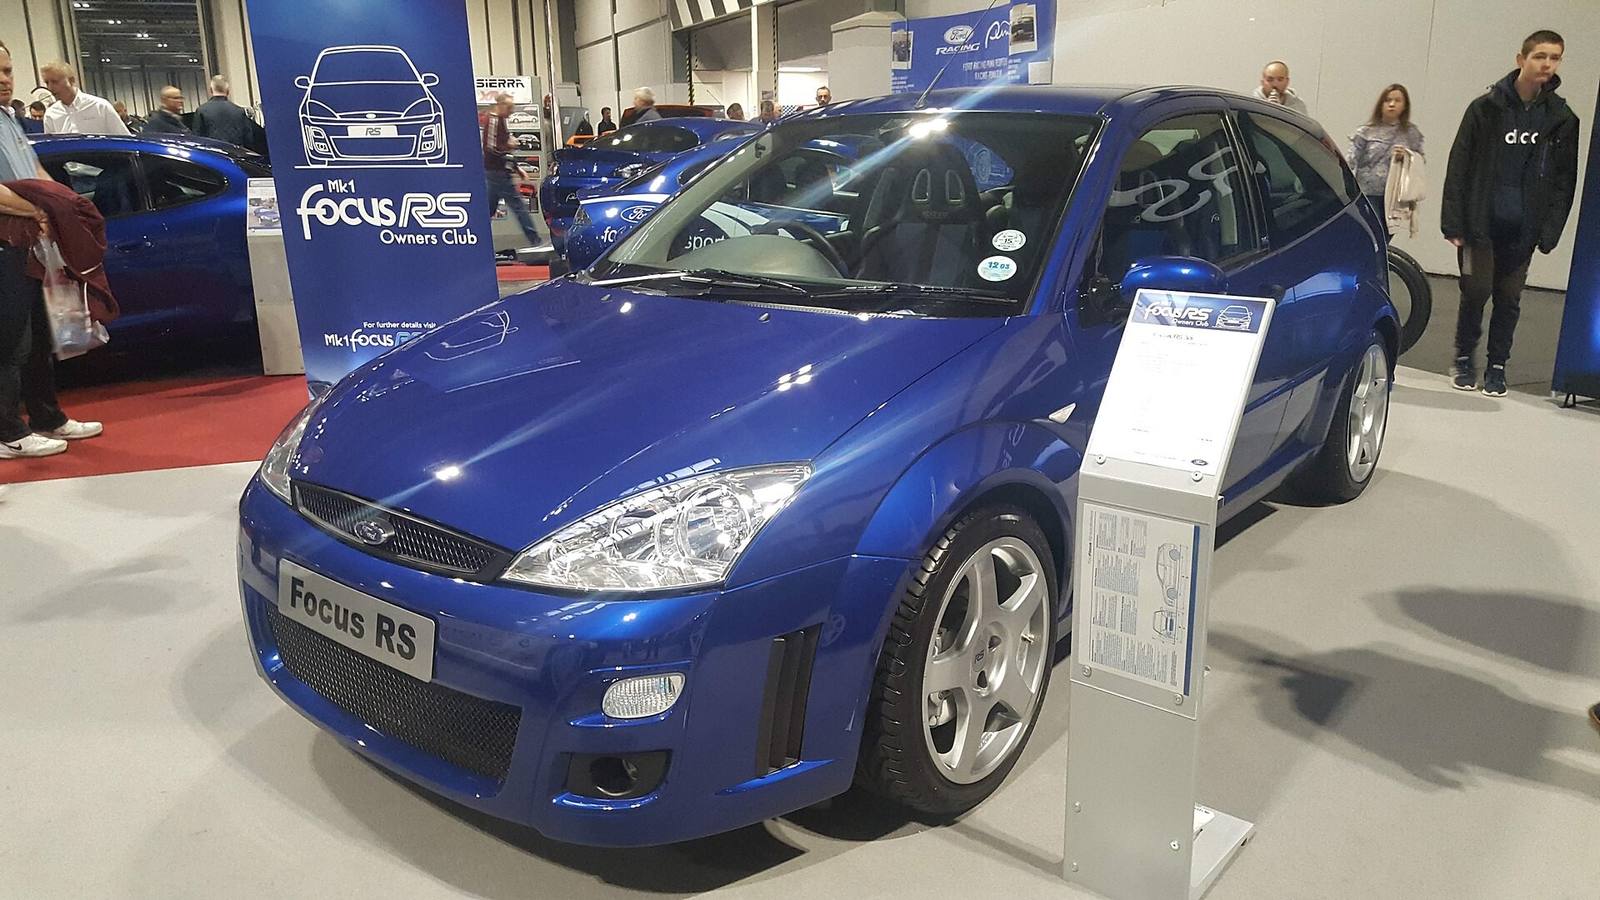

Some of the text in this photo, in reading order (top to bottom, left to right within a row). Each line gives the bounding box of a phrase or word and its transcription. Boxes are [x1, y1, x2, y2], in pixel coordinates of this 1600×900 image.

[936, 43, 980, 55] RACING
[365, 127, 381, 136] RS
[328, 179, 356, 193] Mk1
[380, 228, 477, 244] Owners Club
[290, 576, 416, 660] Focus RS
